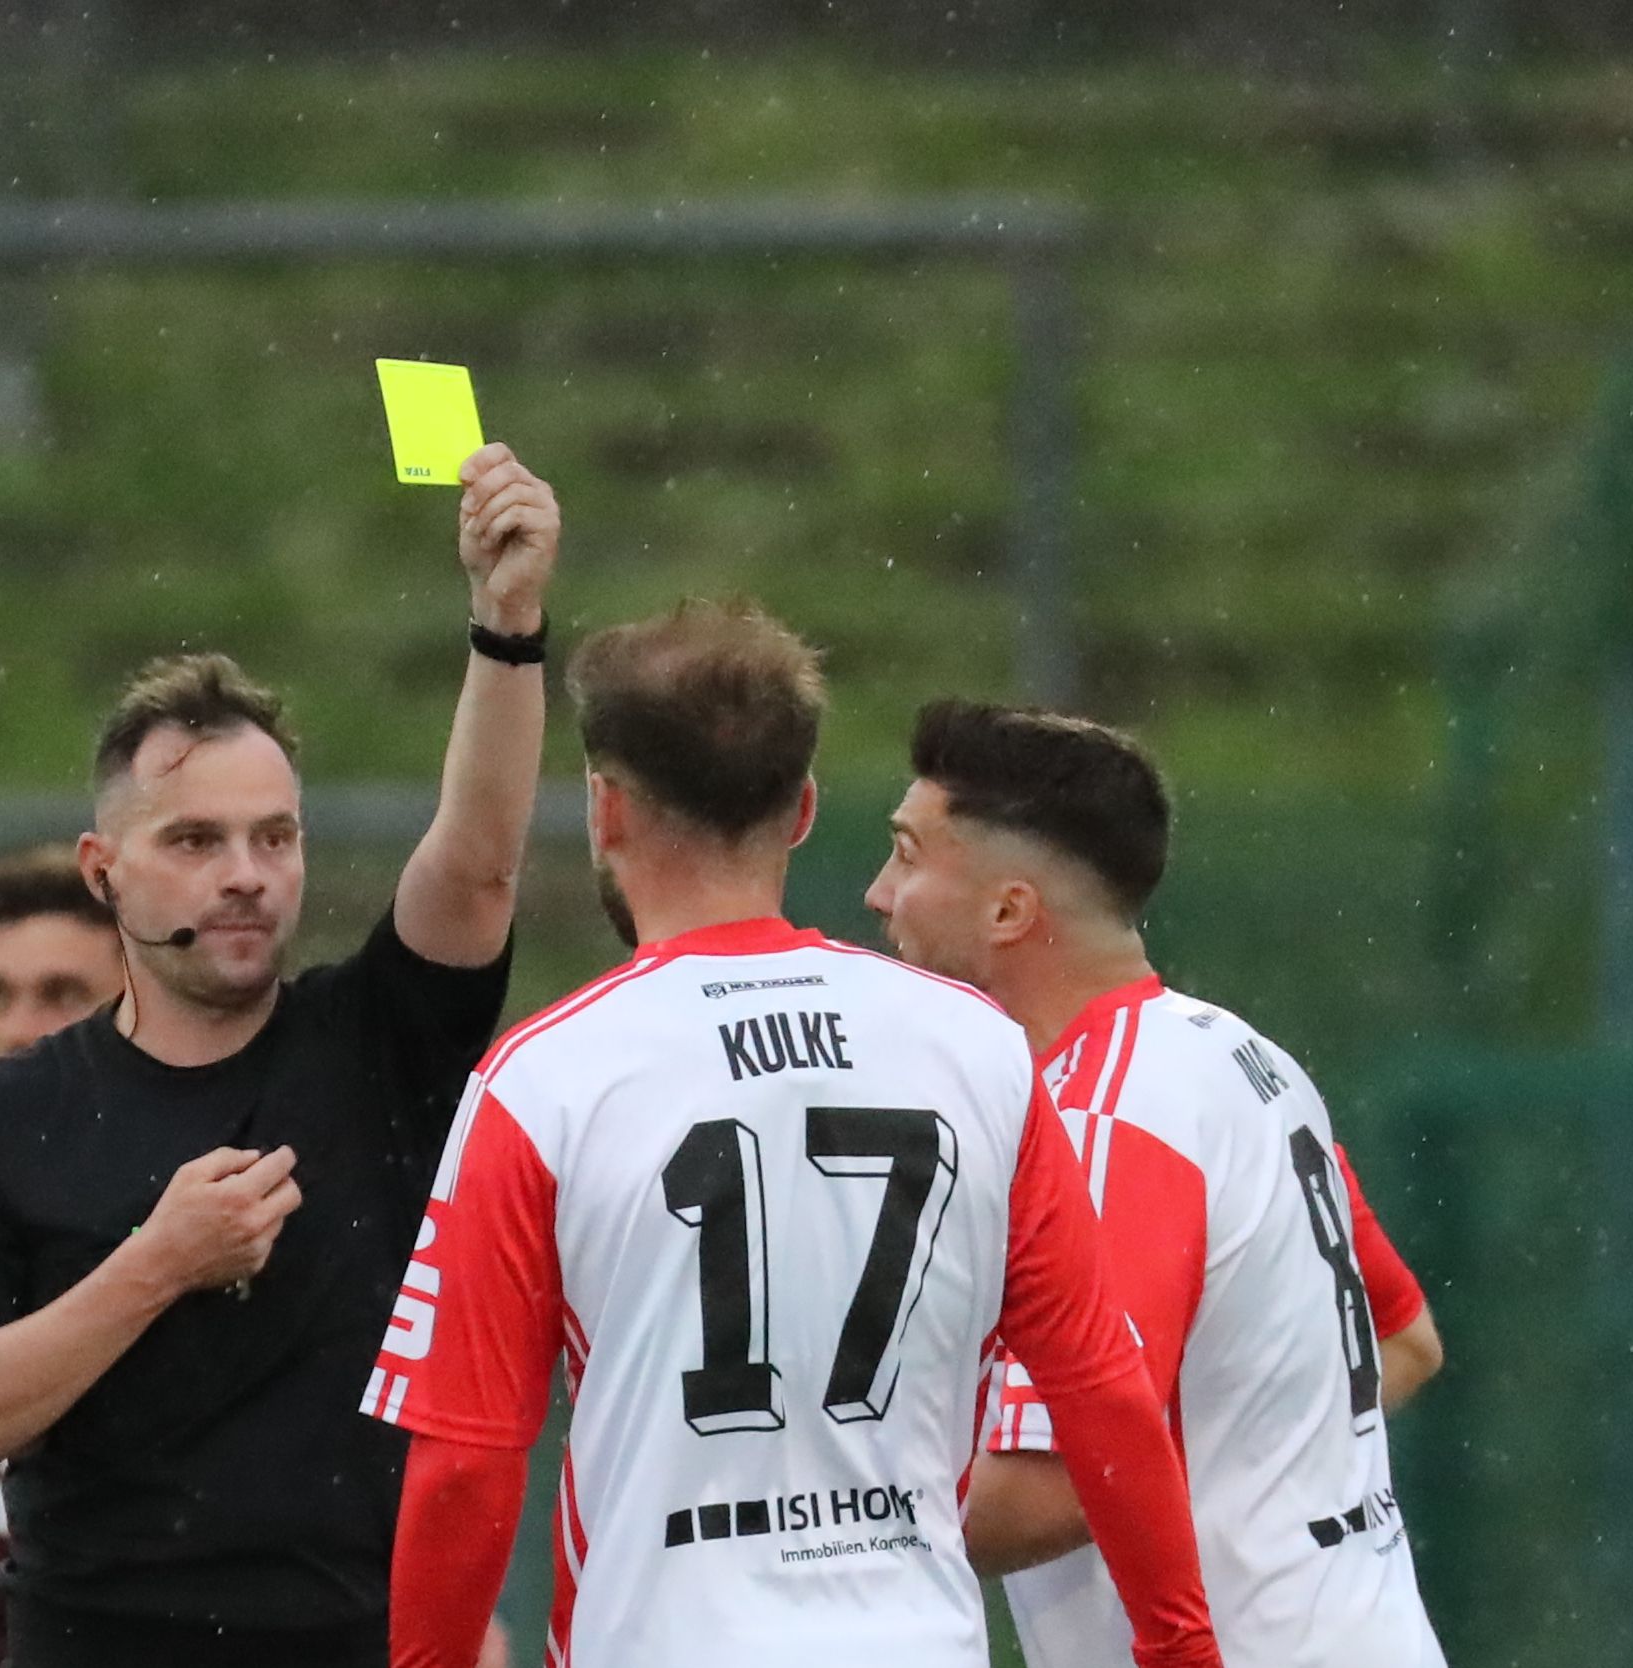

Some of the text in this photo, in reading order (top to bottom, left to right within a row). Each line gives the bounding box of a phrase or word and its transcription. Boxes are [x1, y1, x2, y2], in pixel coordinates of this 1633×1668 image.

[718, 1011, 853, 1081] KULKE
[662, 1106, 958, 1437] 17
[776, 1491, 821, 1532] ISI
